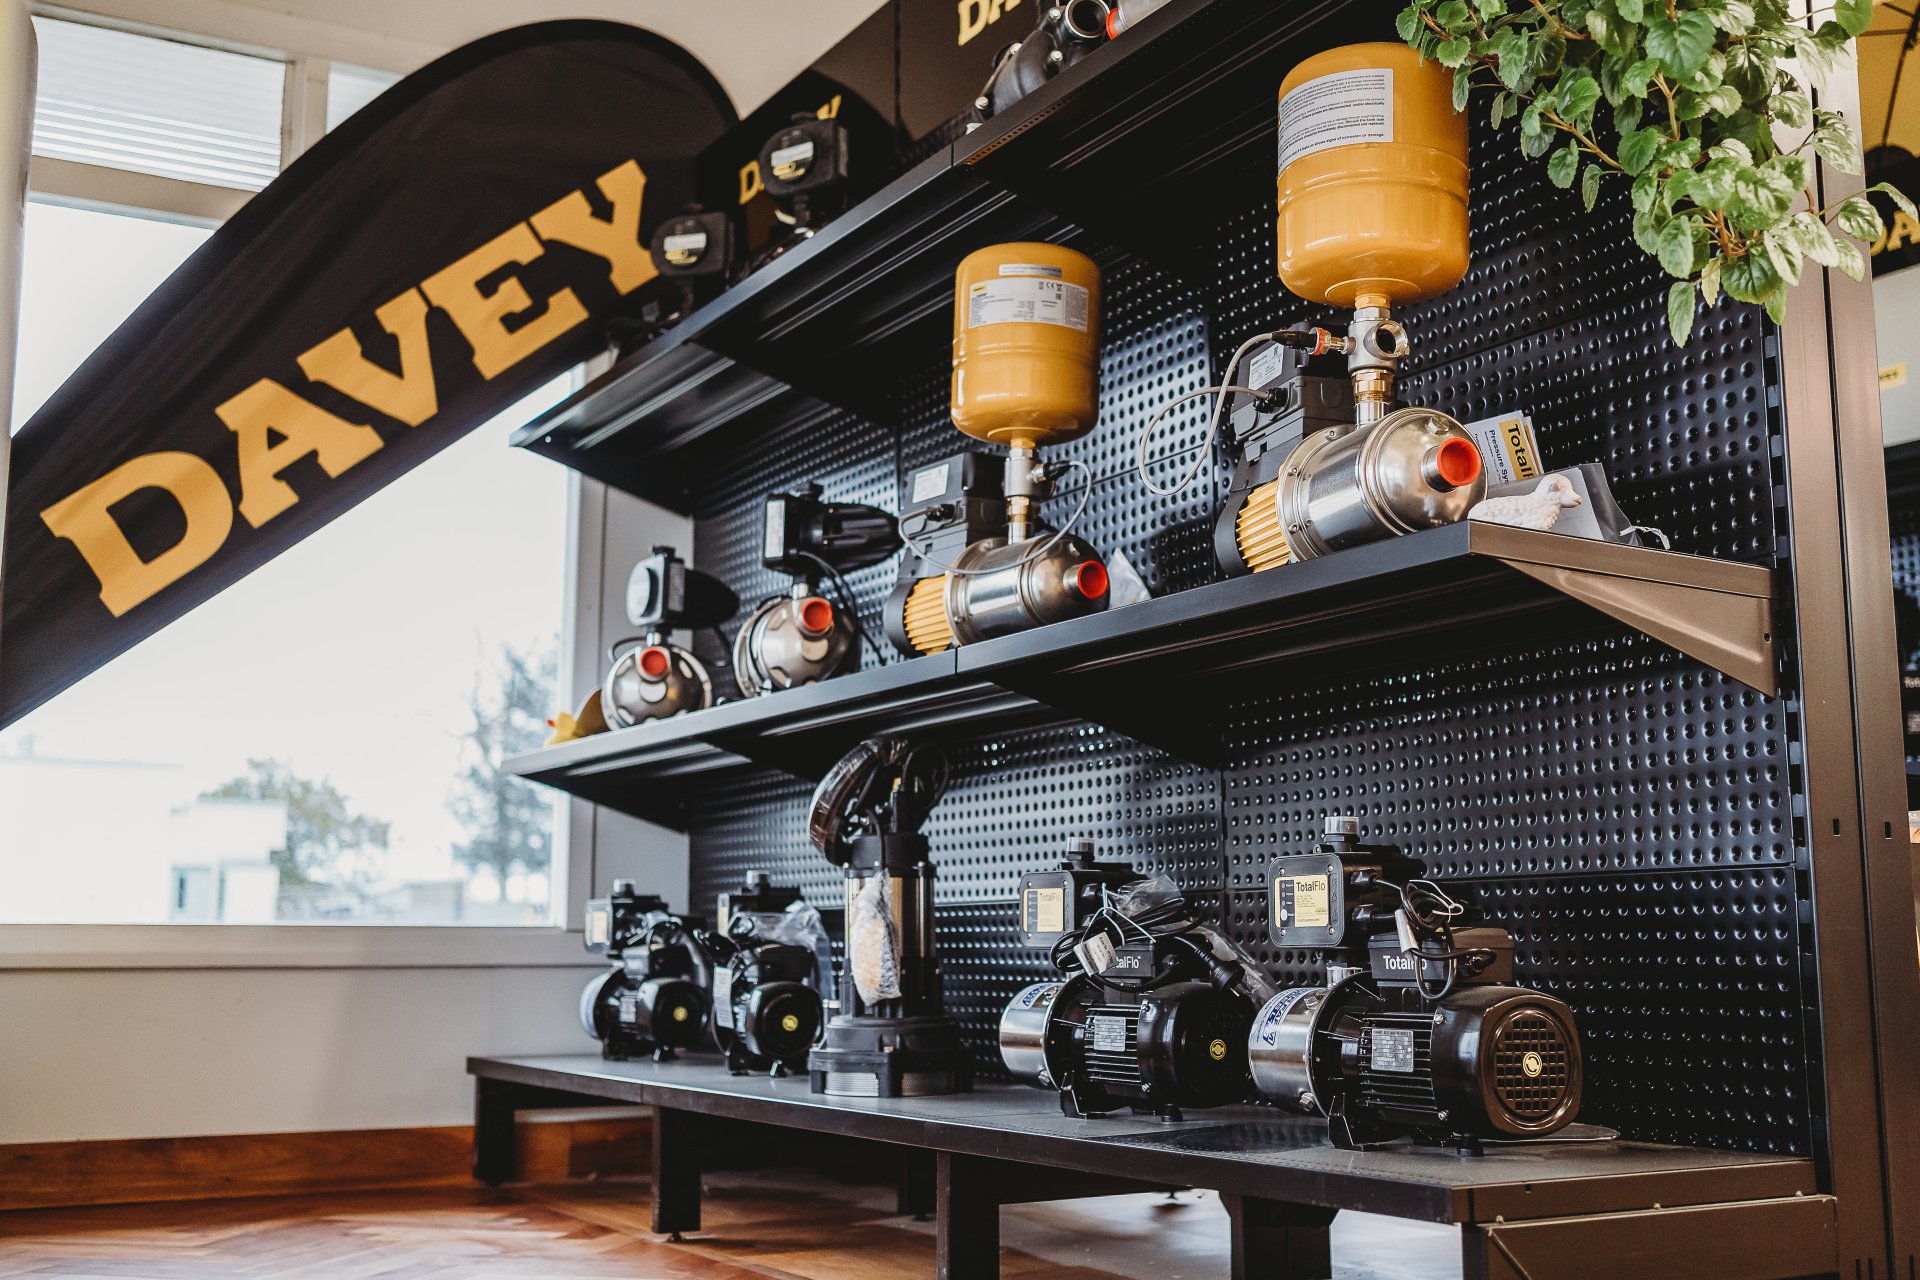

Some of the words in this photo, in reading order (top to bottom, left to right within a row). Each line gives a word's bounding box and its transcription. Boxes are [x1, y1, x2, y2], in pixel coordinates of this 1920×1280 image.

[40, 158, 660, 618] DAVEY
[1489, 429, 1504, 467] Pressure
[1296, 881, 1326, 892] TotalFlo
[1383, 955, 1428, 970] Totalo
